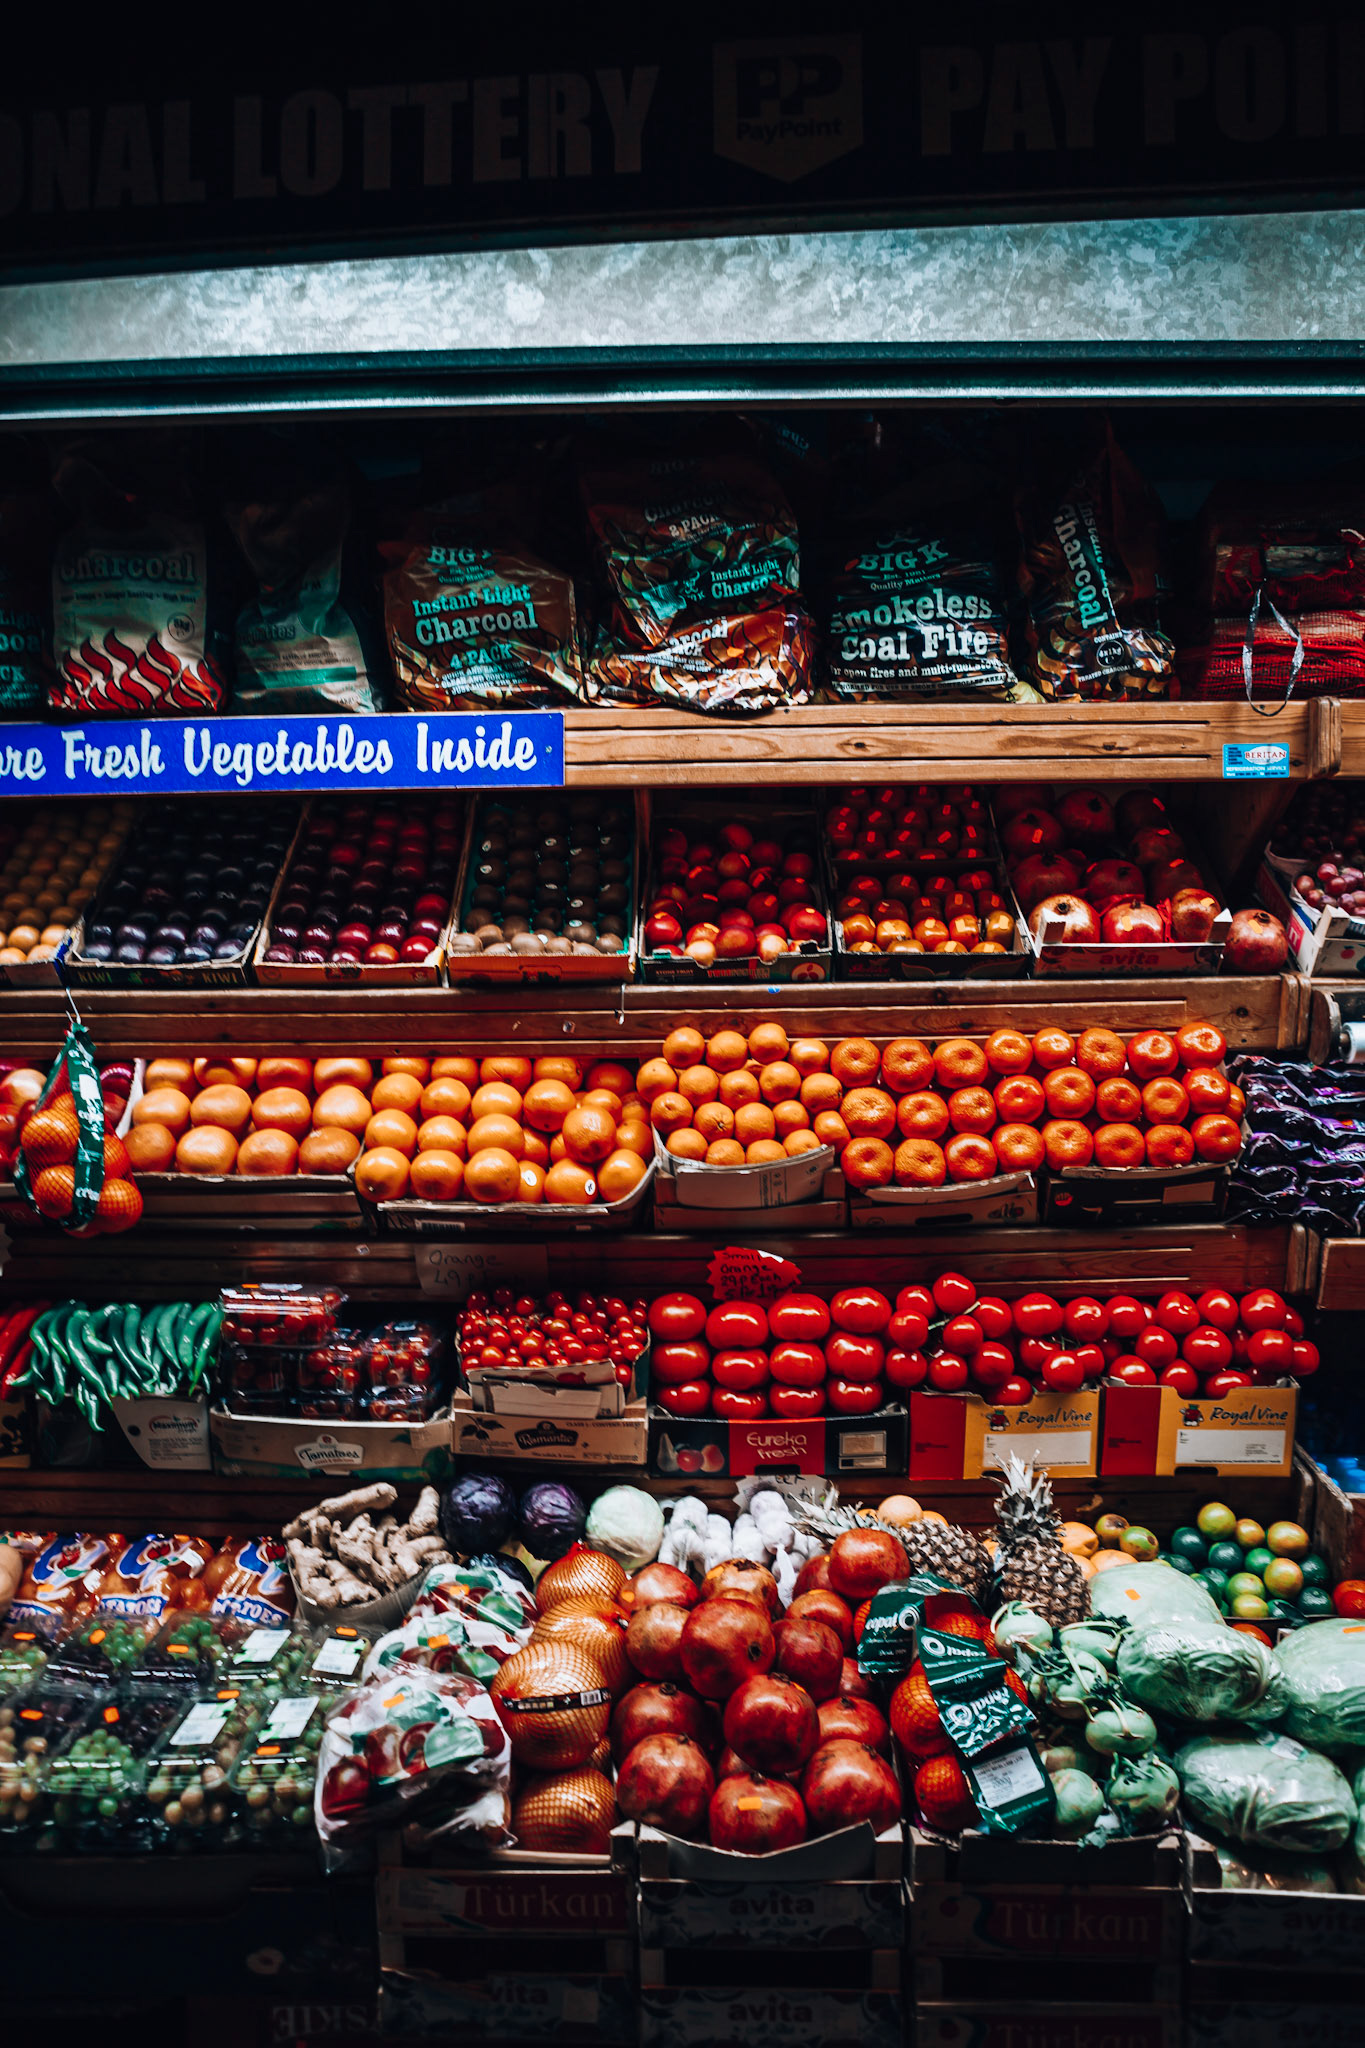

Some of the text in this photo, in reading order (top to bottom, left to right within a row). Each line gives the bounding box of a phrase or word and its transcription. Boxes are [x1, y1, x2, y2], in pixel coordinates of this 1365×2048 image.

[919, 36, 1114, 157] PAY
[233, 66, 661, 199] LOTTERY
[737, 118, 843, 144] PayPoint
[426, 545, 477, 566] BIG
[856, 540, 950, 572] BIG K
[1052, 503, 1110, 630] Charcoal
[711, 558, 781, 582] Instant Light
[412, 584, 532, 618] Instant Light
[829, 587, 993, 634] Smokeless
[415, 601, 539, 647] Charcoal
[841, 622, 988, 662] Coal Fire
[450, 643, 513, 670] 4 PACK
[844, 667, 867, 680] open
[870, 665, 895, 679] fires
[898, 665, 918, 677] and
[0, 722, 538, 786] re Fresh Vegetables Inside
[1245, 751, 1286, 759] BERITAN
[1100, 950, 1160, 966] avita
[77, 970, 112, 985] KIWI
[201, 971, 239, 985] KIWI
[429, 1249, 506, 1269] Orange
[1015, 1407, 1093, 1429] Royal Vine
[1210, 1404, 1289, 1426] Royal Vine
[746, 1431, 808, 1447] Eureka
[756, 1445, 808, 1460] fresh
[466, 1881, 620, 1920] Türkan
[728, 1888, 814, 1915] avita
[997, 1899, 1154, 1944] Türkan
[1282, 1904, 1365, 1932] avita
[727, 1996, 813, 2023] avita
